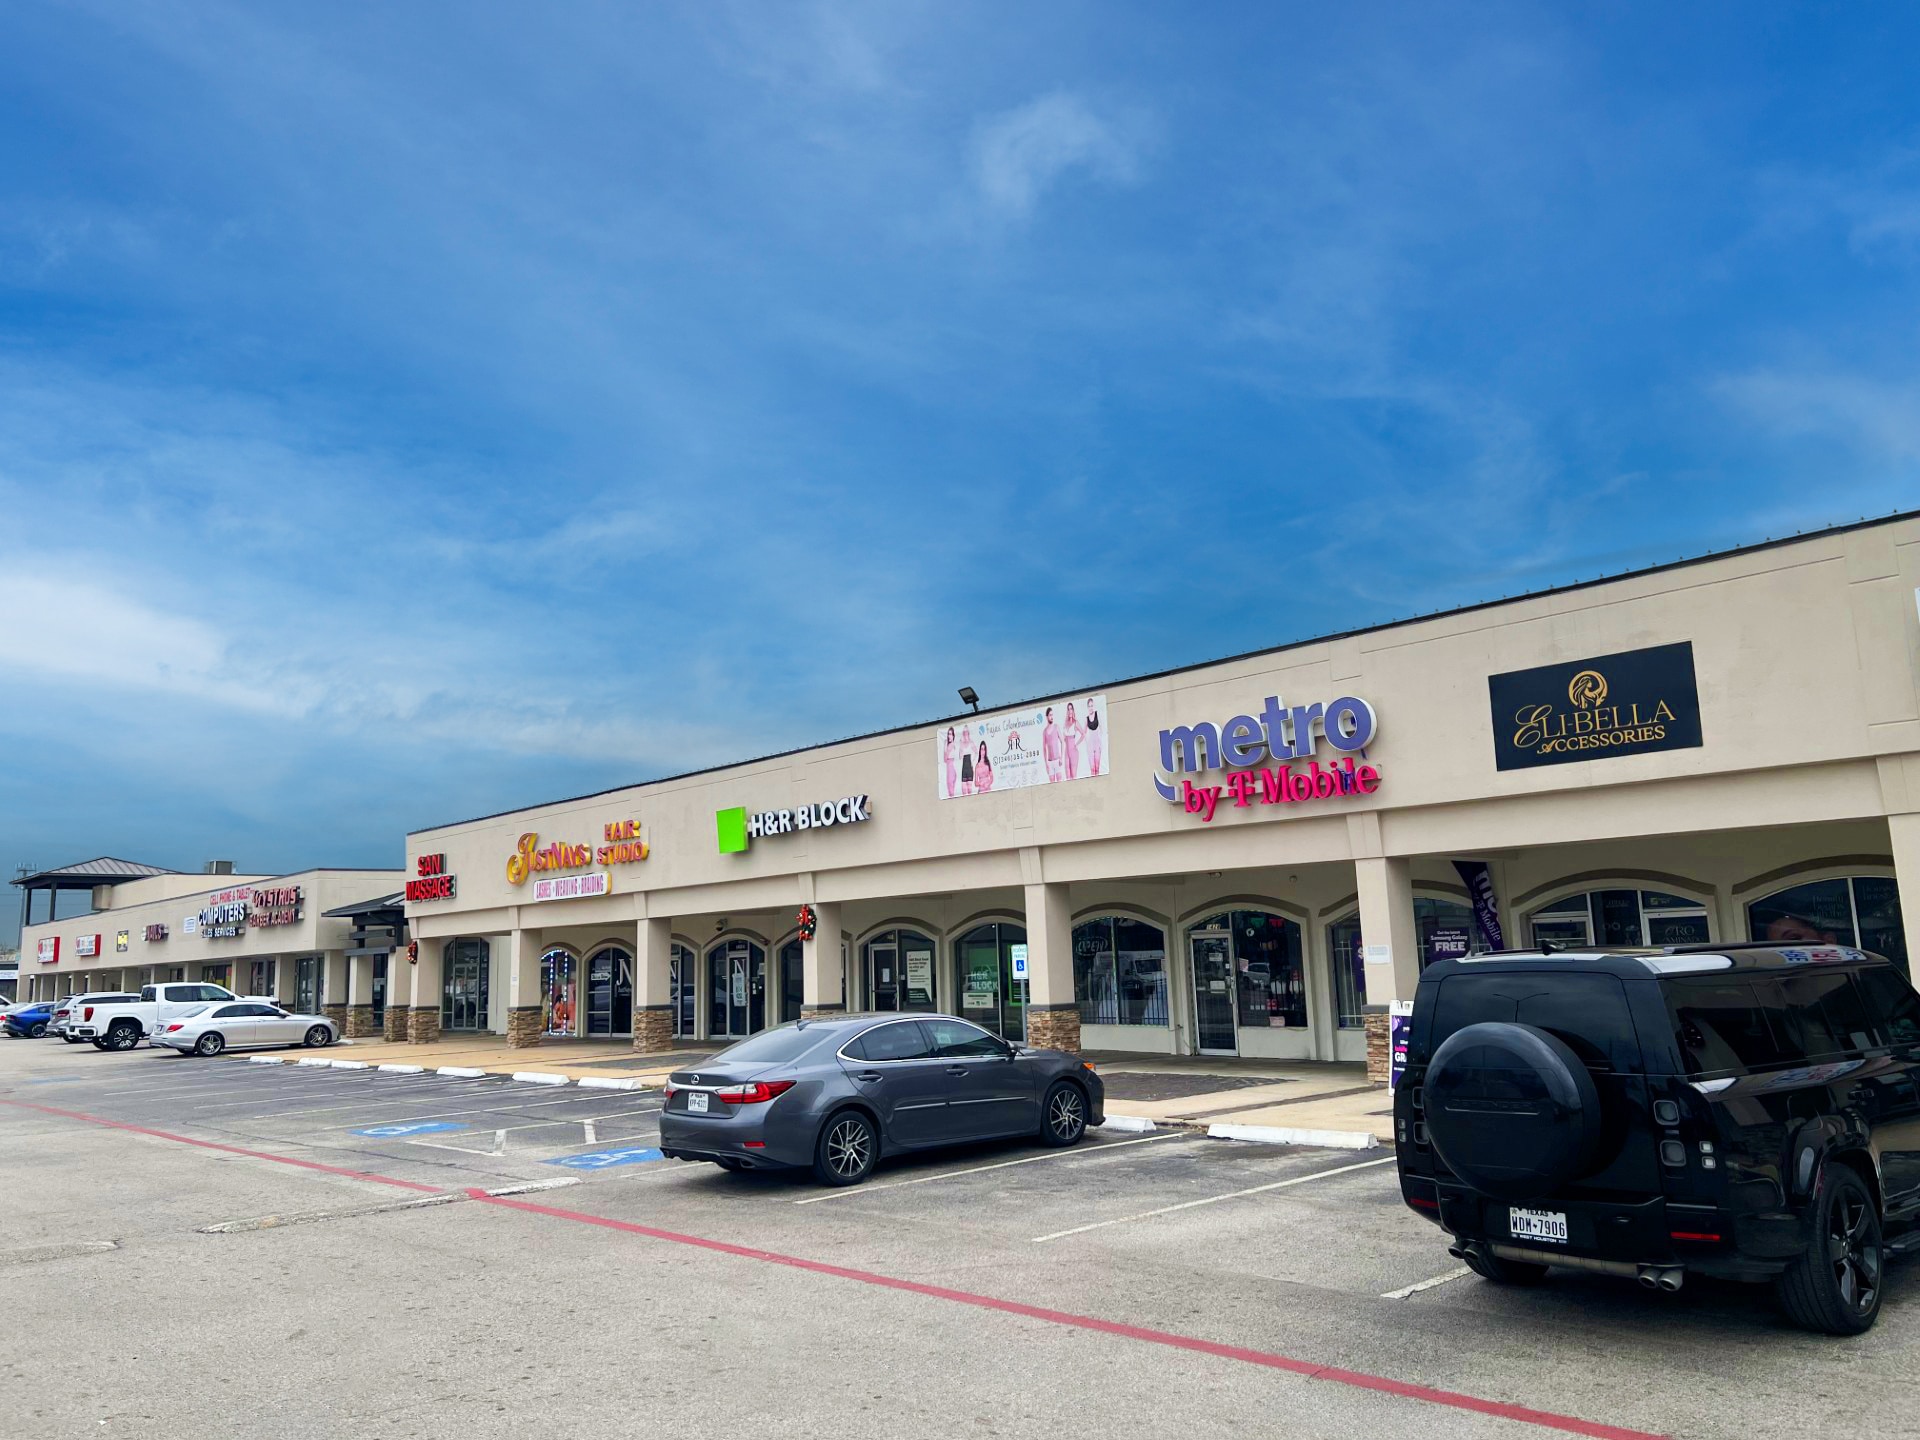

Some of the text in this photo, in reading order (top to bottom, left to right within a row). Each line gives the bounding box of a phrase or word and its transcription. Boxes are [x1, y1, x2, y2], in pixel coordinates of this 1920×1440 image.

[1159, 695, 1377, 773] metro
[1537, 725, 1666, 755] ACCESSORIES
[1182, 780, 1222, 822] by
[751, 794, 868, 838] H&R BLOCK
[604, 820, 638, 842] HAIR
[417, 853, 443, 877] SAN
[597, 841, 645, 865] STUDIO
[405, 874, 452, 902] MASSAGE
[198, 902, 246, 926] COMPUTERS
[1435, 941, 1466, 952] FREE
[1526, 1209, 1549, 1217] TEXAS
